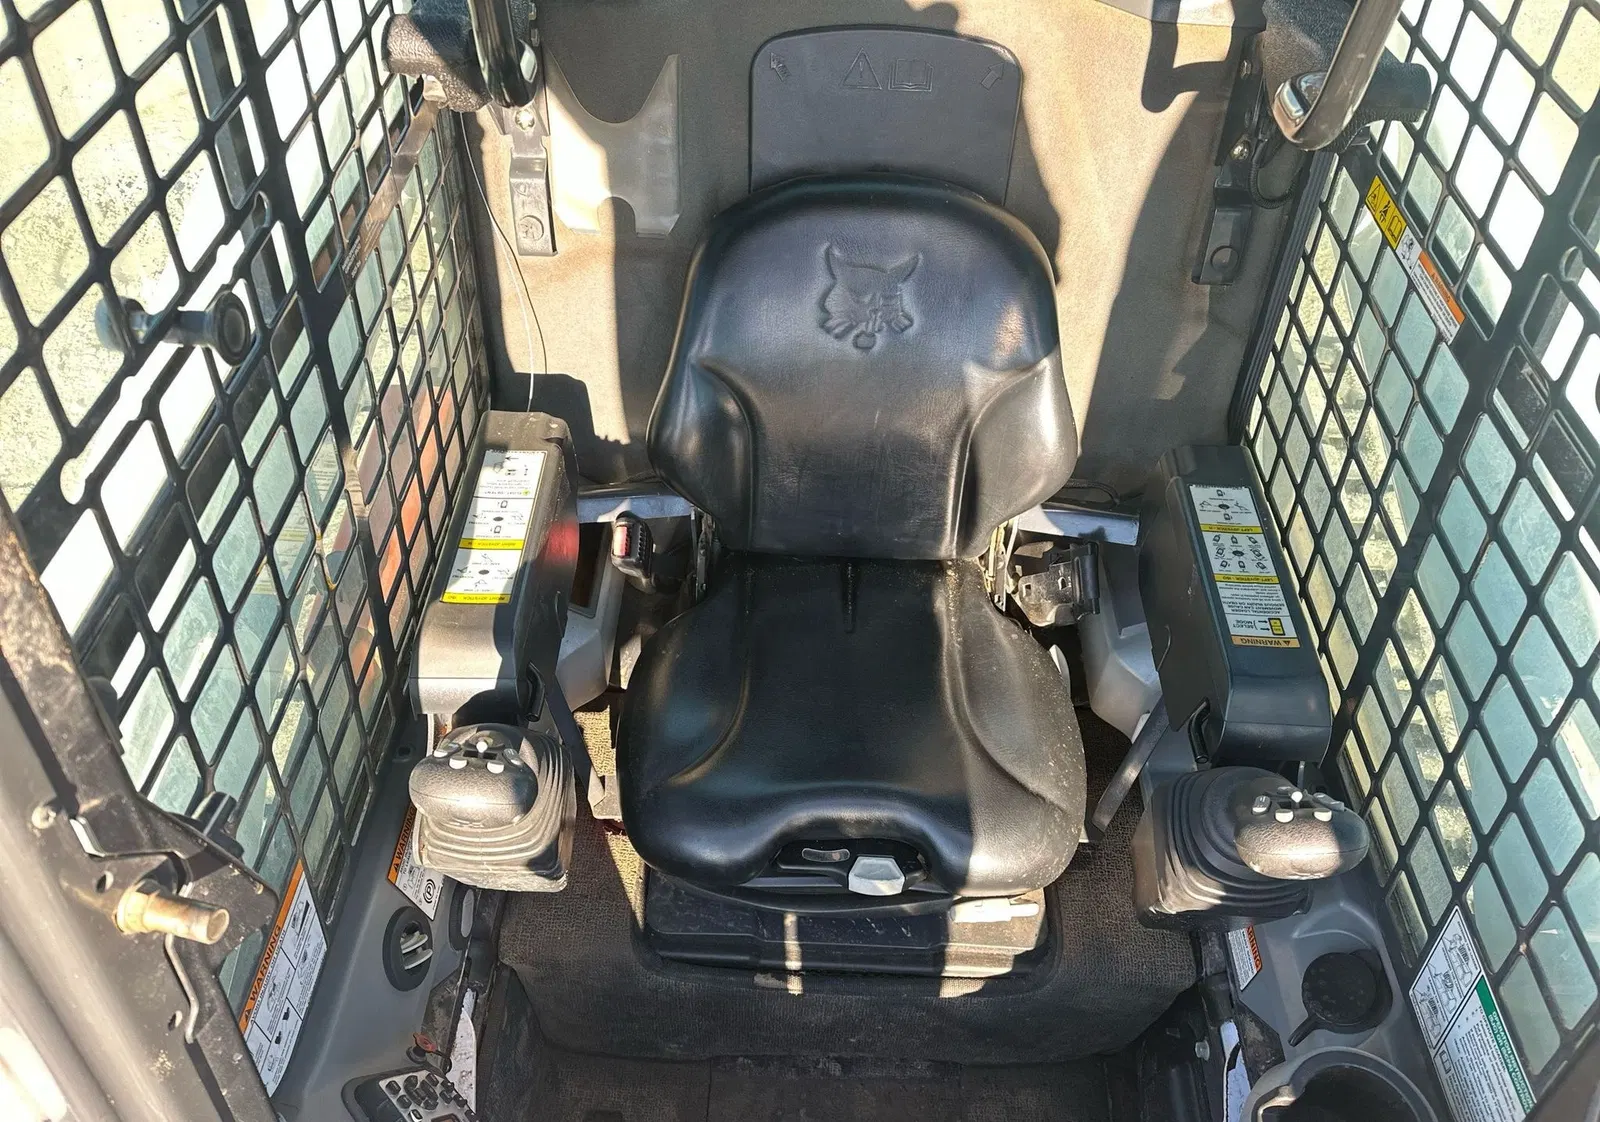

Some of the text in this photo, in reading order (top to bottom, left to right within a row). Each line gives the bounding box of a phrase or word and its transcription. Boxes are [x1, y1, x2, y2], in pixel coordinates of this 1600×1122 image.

[1239, 637, 1281, 646] WARNING
[395, 806, 416, 860] WARNING
[249, 924, 281, 1002] WARNING
[249, 999, 261, 1025] AVOID
[258, 970, 271, 999] INJURY
[1492, 1010, 1512, 1054] OPERATION
